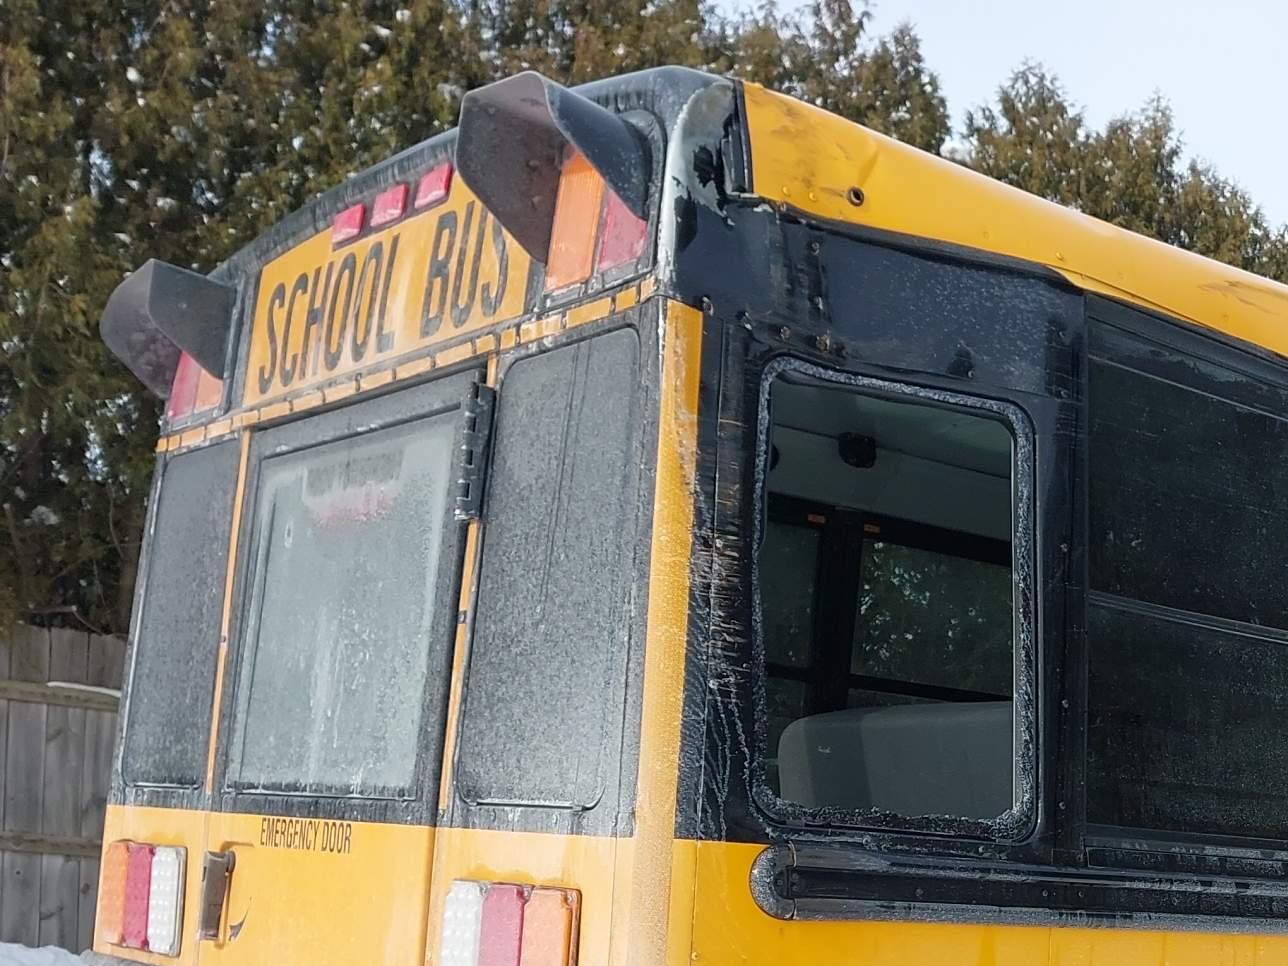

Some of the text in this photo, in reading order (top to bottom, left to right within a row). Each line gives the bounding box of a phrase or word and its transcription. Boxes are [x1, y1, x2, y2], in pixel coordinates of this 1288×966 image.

[258, 200, 508, 394] SCHOOL BUS
[260, 817, 352, 854] EMERGENCY DOOR
